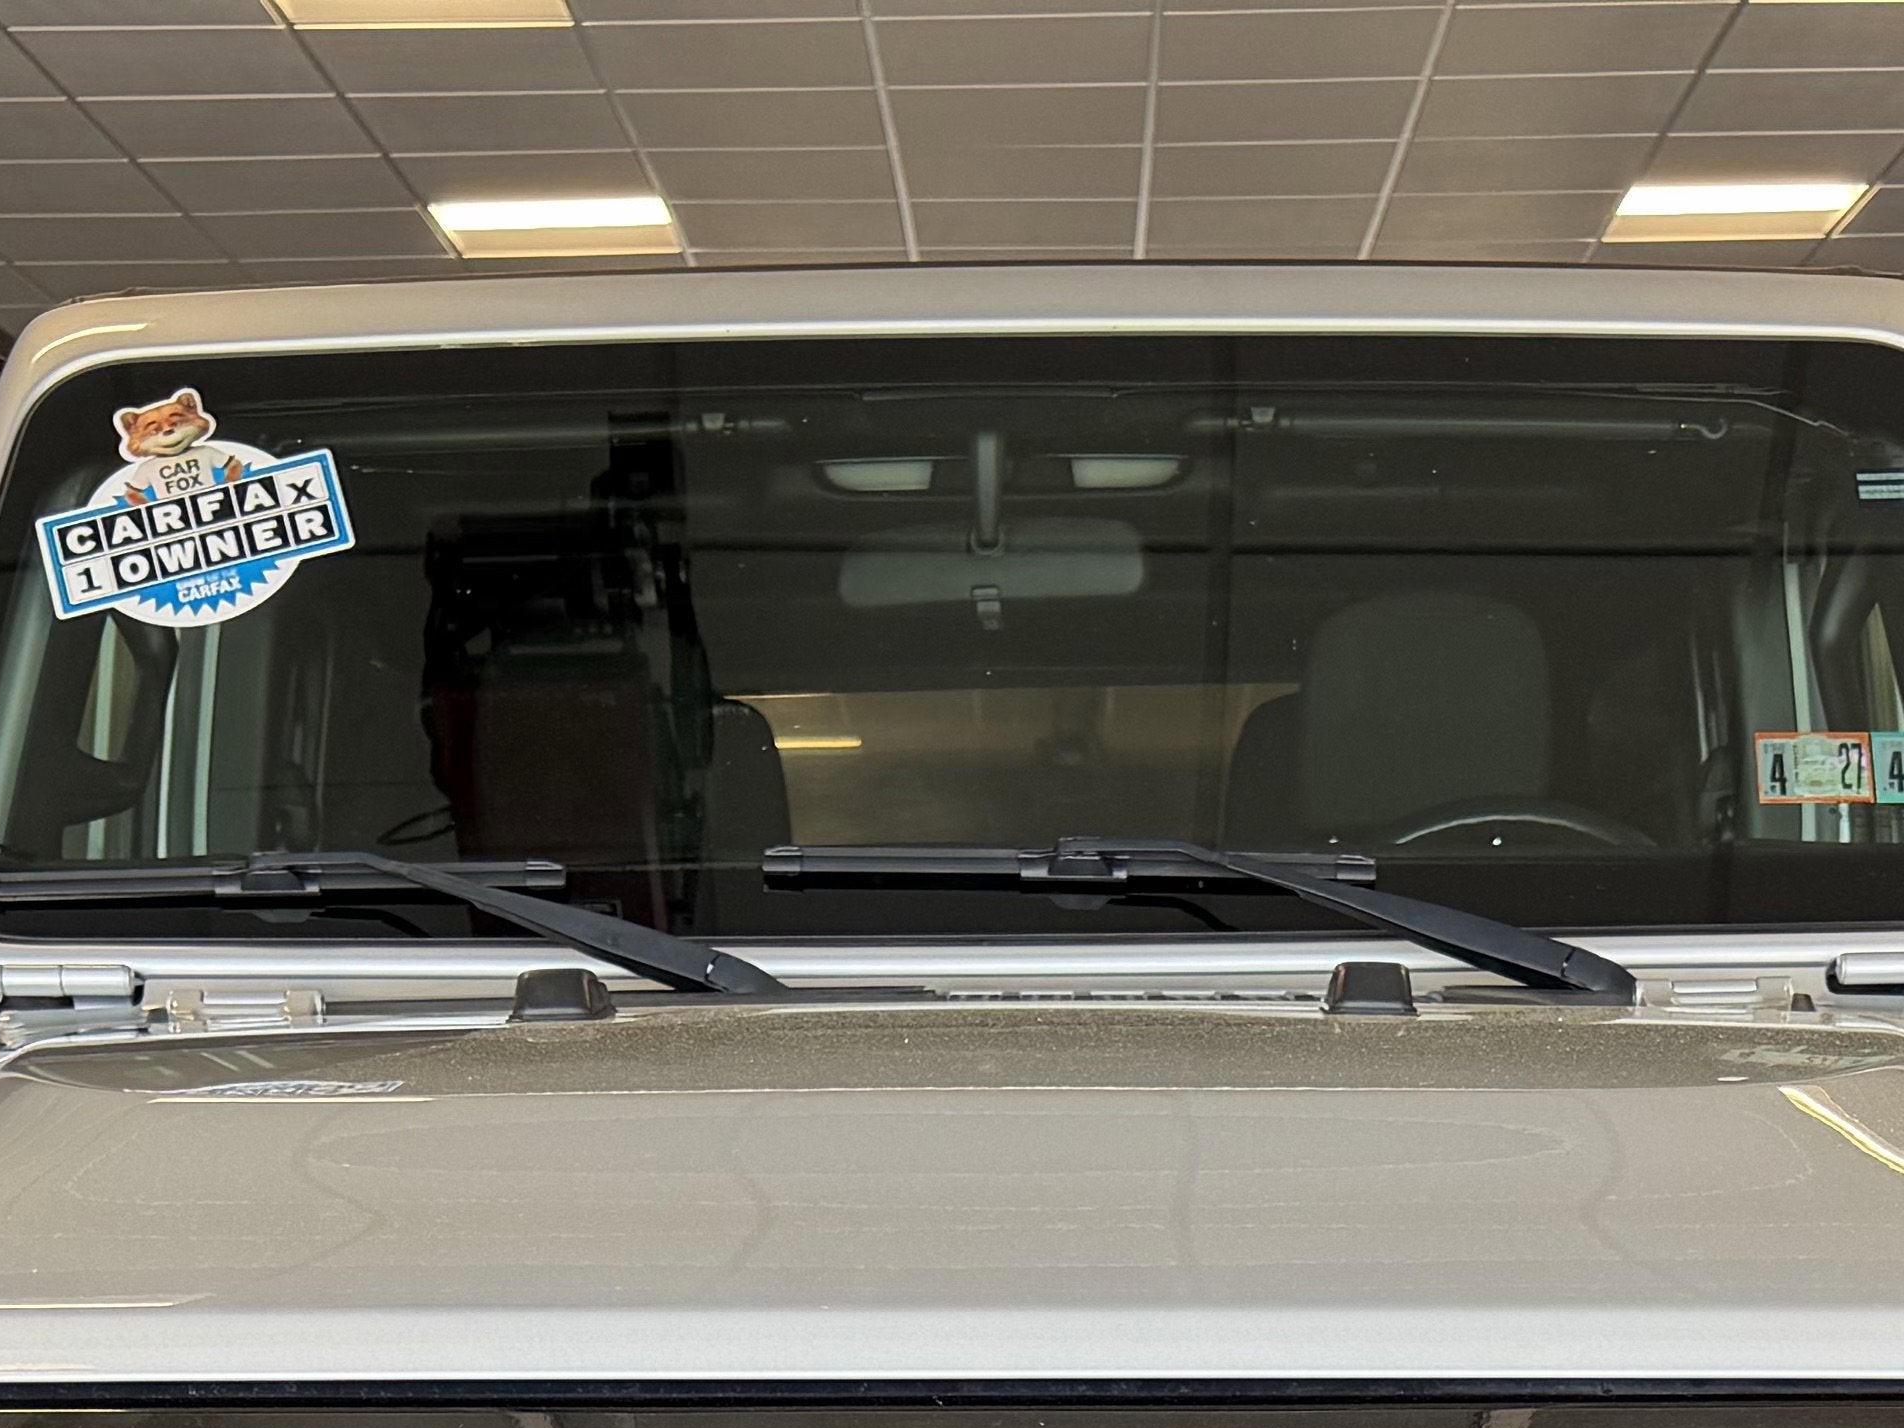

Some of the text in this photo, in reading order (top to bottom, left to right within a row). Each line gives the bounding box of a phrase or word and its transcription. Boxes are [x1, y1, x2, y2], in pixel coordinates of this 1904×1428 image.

[158, 459, 200, 479] CAR
[165, 473, 203, 494] FOX
[65, 477, 315, 554] CARFAX
[76, 566, 103, 594] 1
[117, 509, 328, 584] OWNER
[177, 575, 242, 603] CARFAX
[1770, 753, 1787, 795] 4
